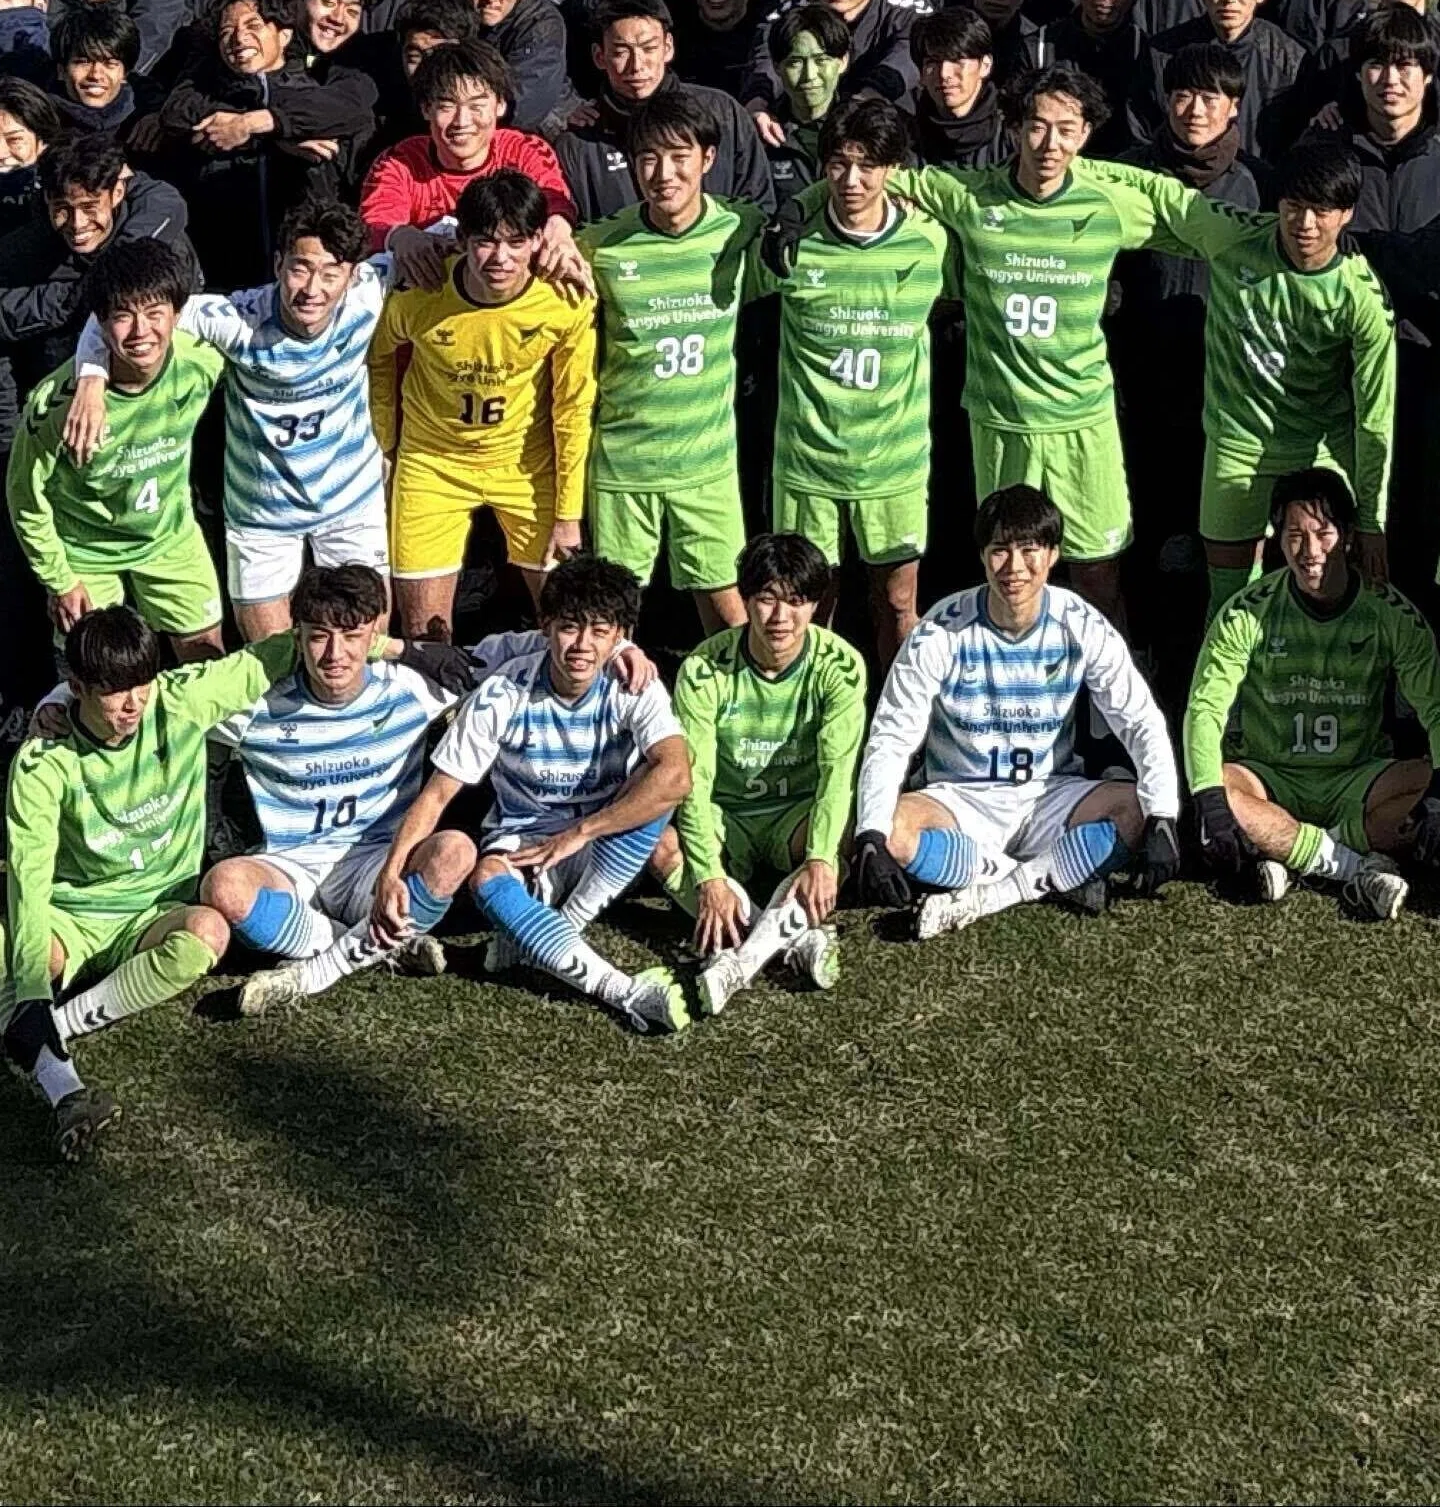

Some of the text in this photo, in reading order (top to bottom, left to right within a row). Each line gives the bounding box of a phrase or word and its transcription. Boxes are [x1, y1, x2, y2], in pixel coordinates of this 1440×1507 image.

[1005, 252, 1067, 270] Shizuoka
[1025, 269, 1093, 288] University
[829, 307, 889, 321] Shizuoka
[1005, 293, 1058, 338] 99
[654, 334, 705, 380] 38
[829, 347, 881, 391] 40
[458, 392, 507, 425] 16
[274, 409, 326, 448] 33
[135, 476, 160, 514] 4
[982, 702, 1041, 719] Shizuoka
[1292, 712, 1339, 753] 19
[304, 755, 371, 776] Shizuoka
[988, 745, 1034, 787] 18
[310, 795, 358, 834] 10
